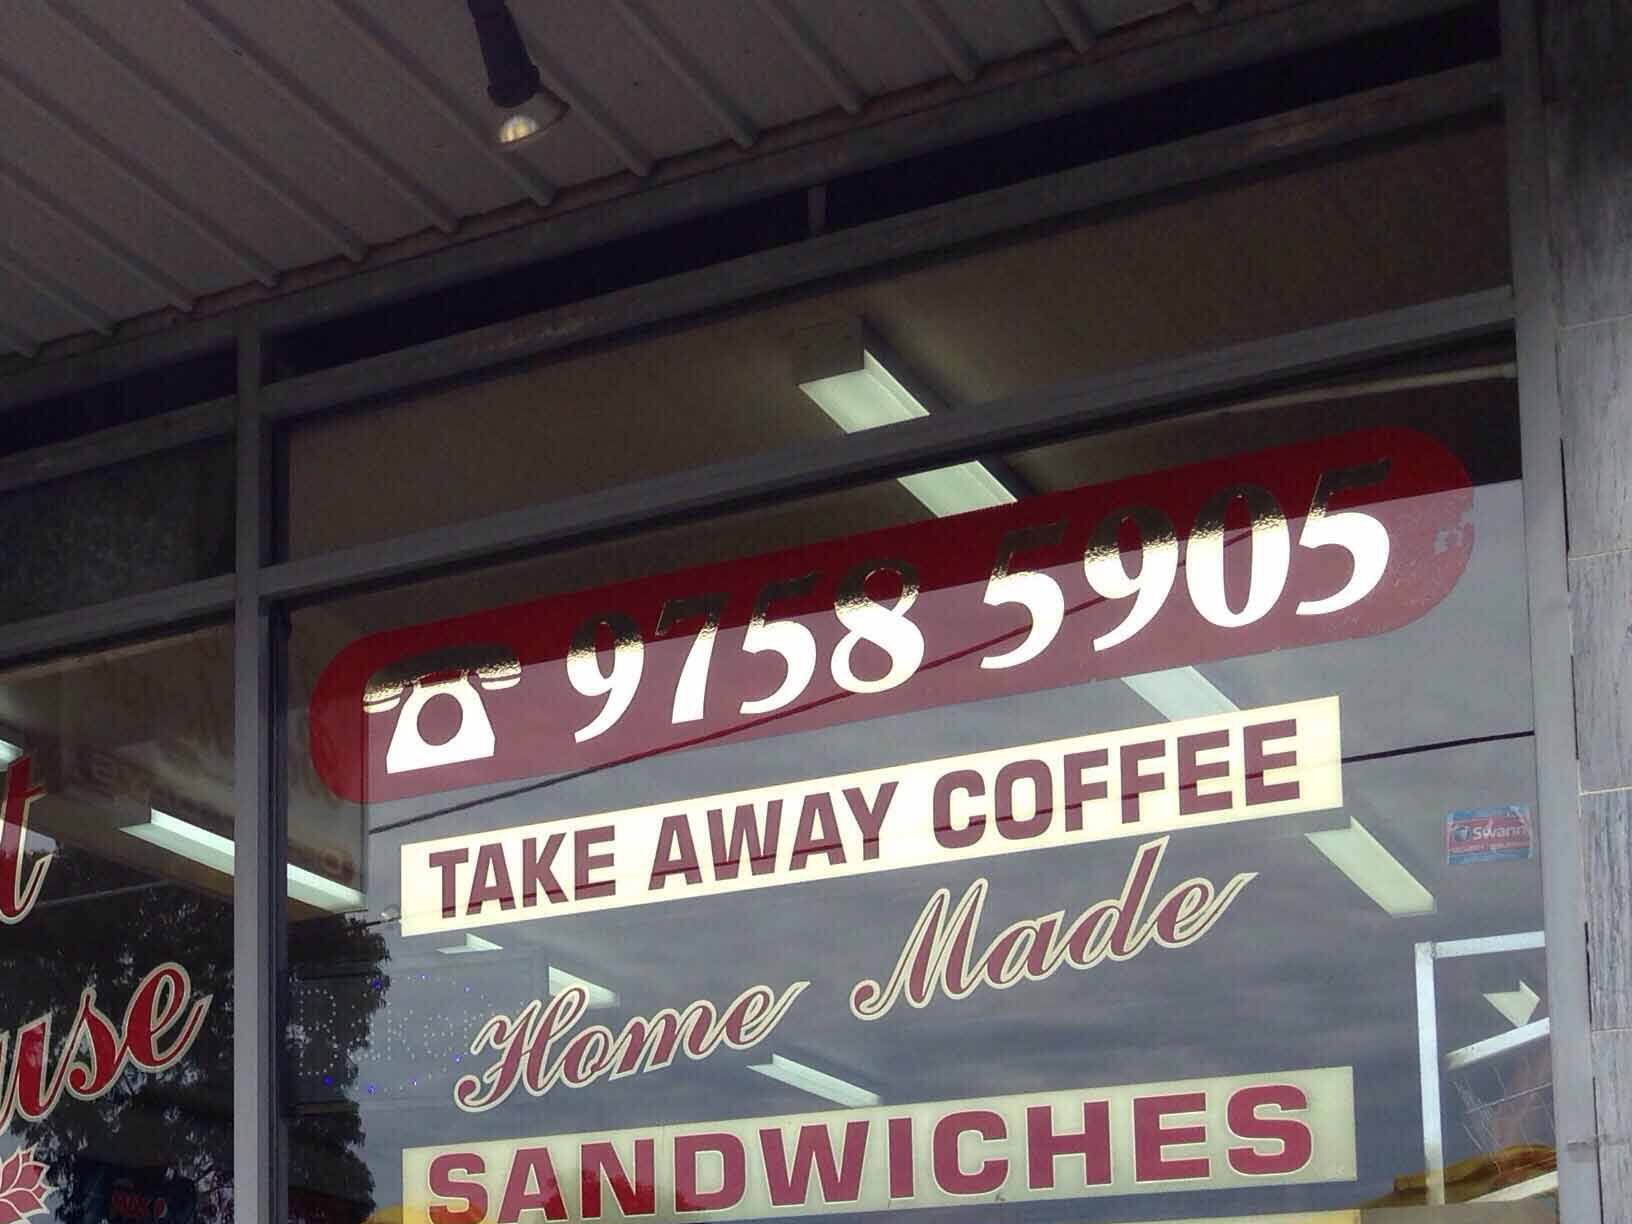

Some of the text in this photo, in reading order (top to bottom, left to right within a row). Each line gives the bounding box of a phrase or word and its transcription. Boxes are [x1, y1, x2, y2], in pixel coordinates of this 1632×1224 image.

[569, 455, 1393, 744] 9758 5905
[428, 717, 1302, 920] TAKE AWAY COFFEE
[452, 834, 1260, 1114] Home Made
